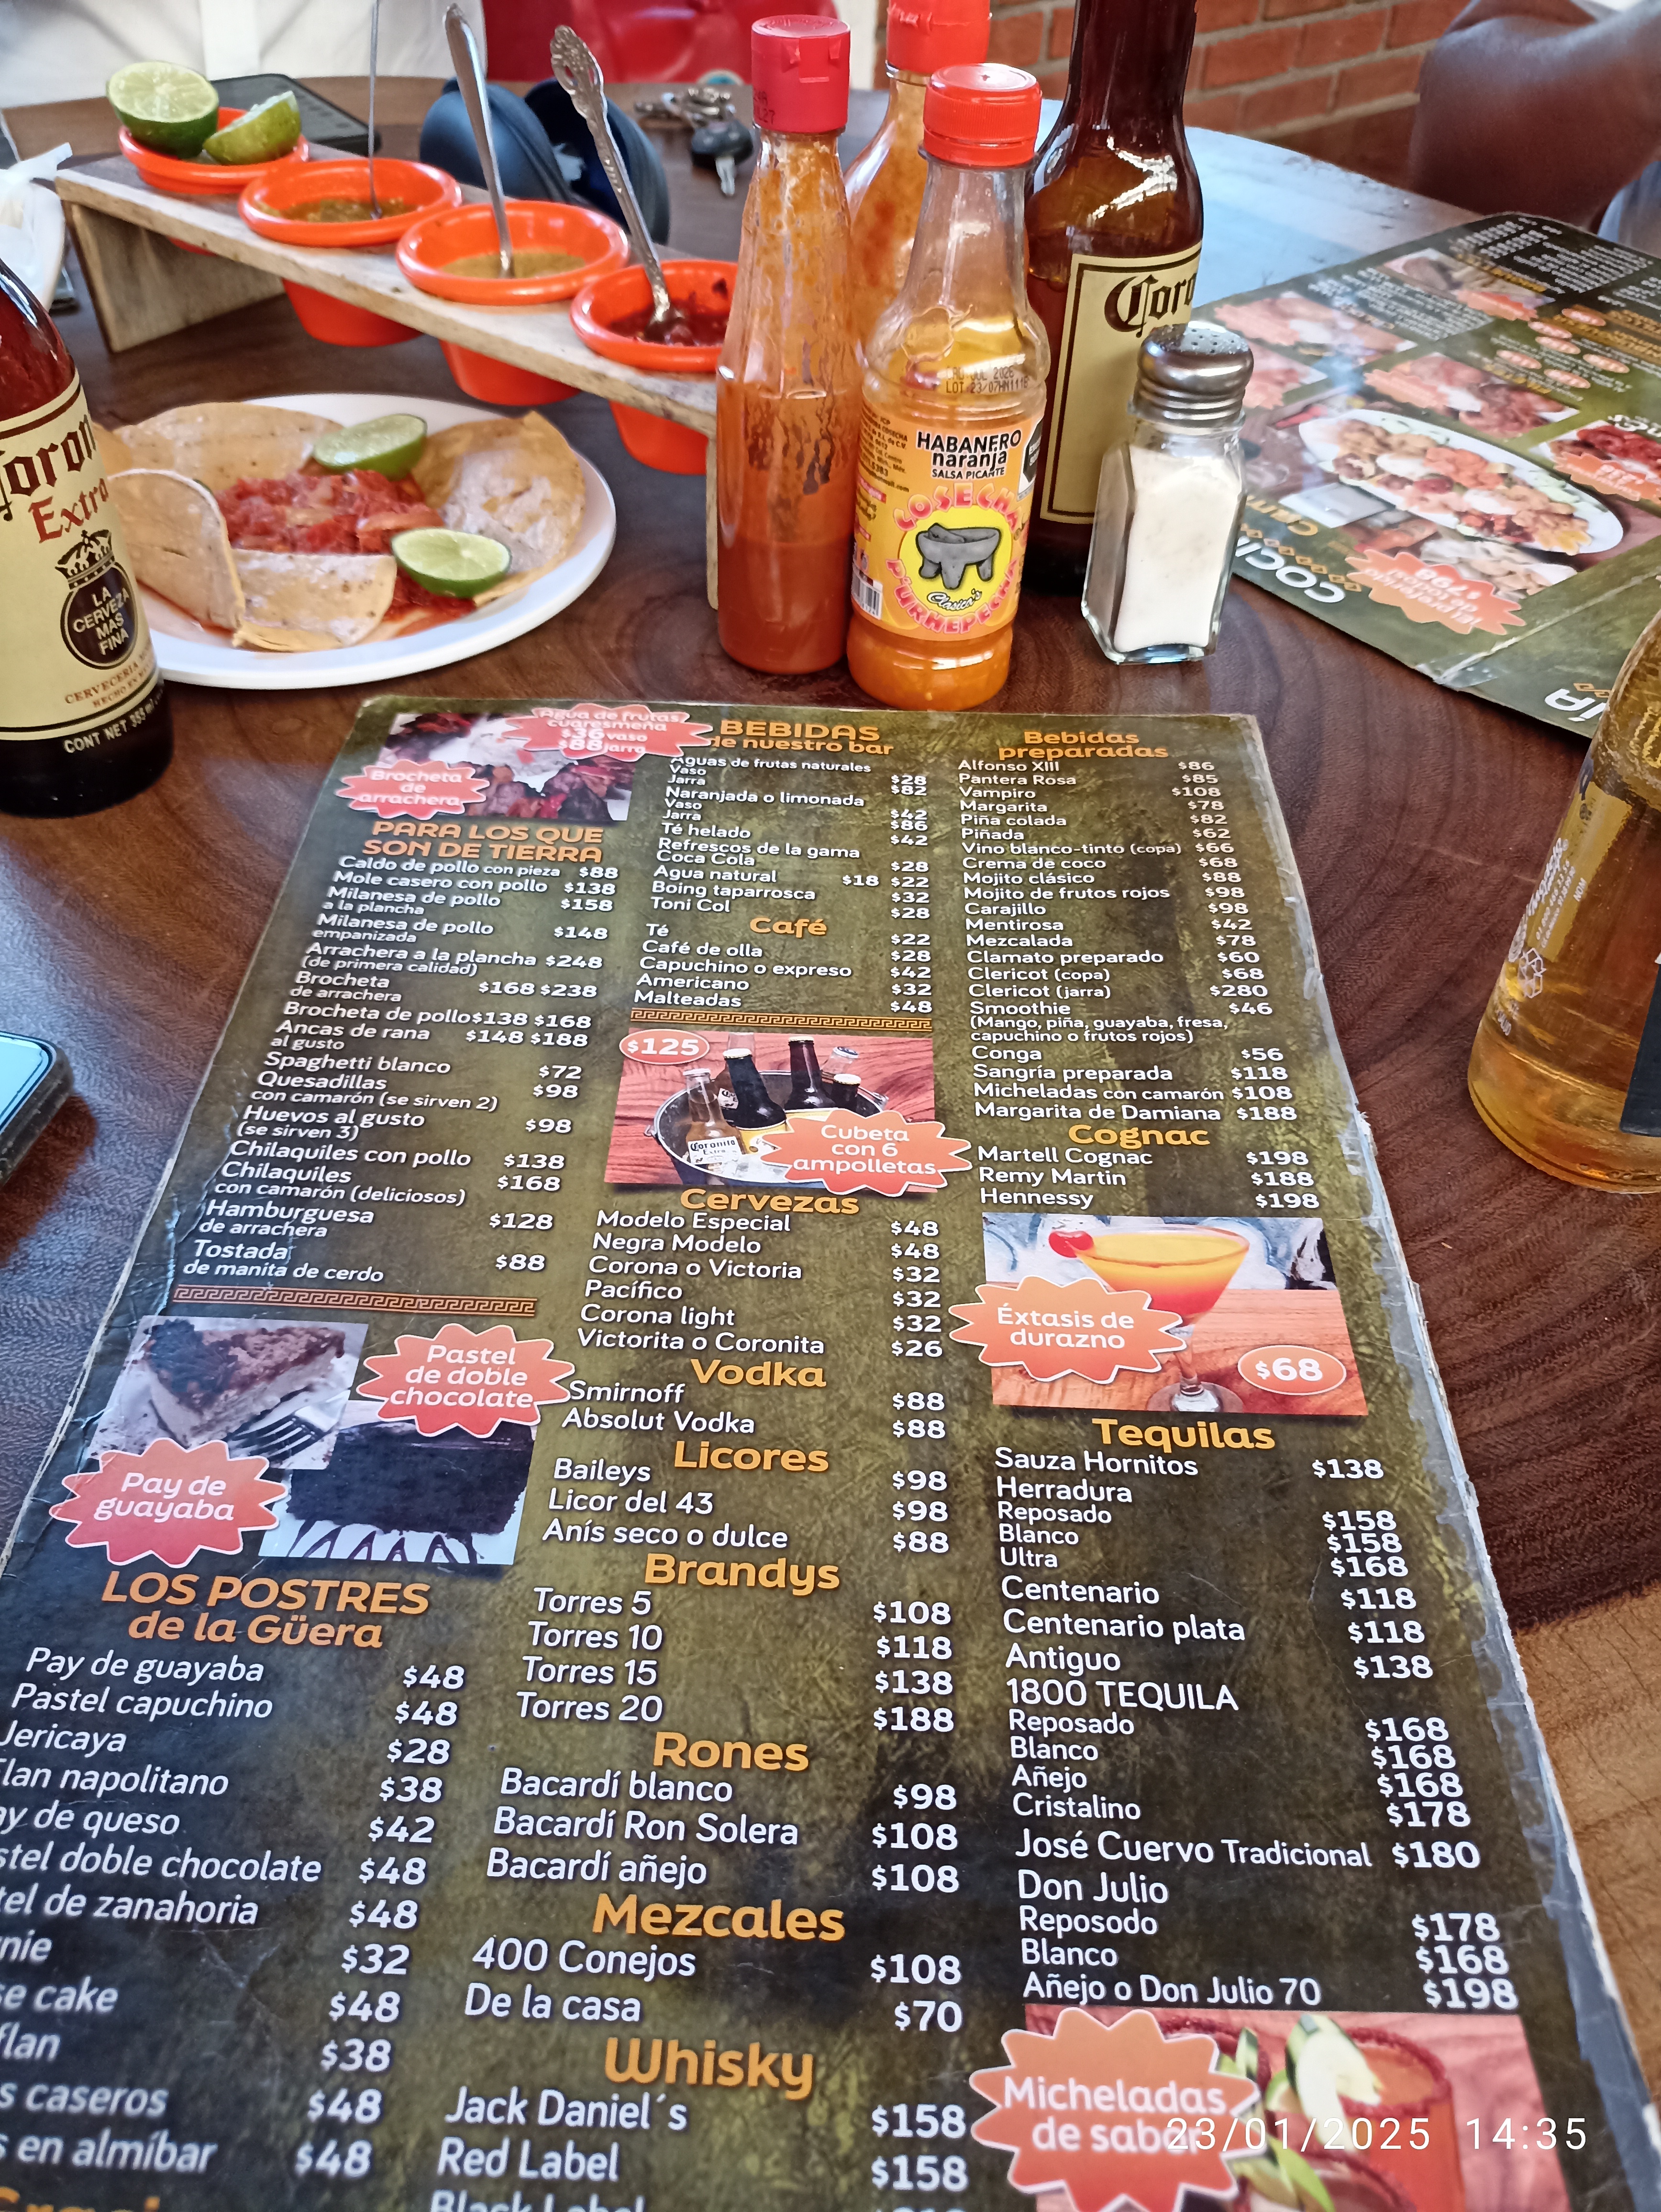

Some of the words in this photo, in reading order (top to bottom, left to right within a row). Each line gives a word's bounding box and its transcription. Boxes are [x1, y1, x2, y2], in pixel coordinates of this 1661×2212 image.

[946, 381, 964, 393] LOT
[917, 430, 1021, 453] HABANERO
[933, 447, 1007, 472] naranja
[932, 469, 963, 479] SALSA
[966, 467, 1005, 479] PICANTE
[92, 586, 112, 607] LA
[73, 587, 130, 633] CERVEZA
[95, 612, 124, 640] MAS
[99, 628, 129, 655] FINA
[539, 709, 590, 720] Agua
[594, 711, 619, 720] de
[622, 713, 679, 722] frutas
[63, 732, 100, 753] CONT
[103, 719, 127, 741] NET
[562, 728, 605, 740] $36
[607, 732, 648, 742] vaso
[721, 719, 879, 741] BEBIDAS
[1024, 731, 1139, 743] Bebidas
[558, 739, 603, 751] $88
[710, 736, 736, 747] de
[743, 739, 842, 751] nuestro
[849, 741, 894, 754] bar
[999, 745, 1168, 761] preparadas
[670, 757, 726, 769] Aguas
[731, 758, 749, 767] de
[754, 759, 797, 768] frutas
[802, 762, 871, 772] naturales
[670, 764, 706, 775] Vaso
[891, 774, 926, 785] $28
[958, 760, 1027, 771] Alfonso
[1032, 762, 1059, 771] XIII
[1178, 762, 1214, 770] $86
[371, 770, 463, 783] Brocheta
[668, 774, 705, 785] Jarra
[891, 785, 926, 796] $82
[400, 783, 426, 794] de
[357, 794, 460, 807] arrachera
[961, 814, 1000, 825] Piña
[1007, 815, 1066, 825] colada
[1190, 814, 1227, 824] $82
[373, 821, 461, 838] PARA
[469, 825, 528, 840] LOS
[536, 827, 603, 844] QUE
[363, 840, 431, 856] SON
[438, 842, 481, 858] DE
[489, 844, 601, 863] TIERRA
[962, 842, 1004, 854] Vino
[1010, 843, 1124, 854] blanco-tinto
[1130, 843, 1181, 855] (copa)
[1196, 843, 1234, 852] $66
[339, 855, 397, 870] Caldo
[400, 859, 426, 871] de
[430, 861, 479, 874] pollo
[517, 865, 560, 877] pieza
[580, 867, 618, 878] $88
[646, 924, 668, 936] Té
[891, 934, 930, 945] $22
[750, 918, 826, 938] Café
[642, 940, 690, 954] Café
[697, 942, 720, 955] de
[727, 944, 762, 957] olla
[891, 950, 930, 962] $28
[627, 1037, 699, 1055] $125
[974, 1064, 1055, 1082] Sangría
[1063, 1065, 1172, 1083] preparada
[1231, 1067, 1288, 1080] $118
[251, 1088, 288, 1103] con
[290, 1092, 374, 1104] camarón
[379, 1092, 409, 1106] (se
[413, 1095, 471, 1108] sirven
[476, 1096, 497, 1112] 2)
[821, 1125, 909, 1141] Cubeta
[1069, 1125, 1210, 1149] Cognac
[690, 1140, 736, 1151] Coronita
[832, 1144, 875, 1156] con
[882, 1143, 897, 1157] 6
[794, 1159, 936, 1174] ampolletas
[681, 1189, 859, 1214] Cervezas
[981, 1188, 1093, 1209] Hennessy
[1256, 1194, 1319, 1208] $198
[194, 1239, 288, 1259] Tostada
[496, 1254, 544, 1271] $88
[593, 1232, 664, 1254] Negra
[672, 1234, 760, 1253] Modelo
[891, 1243, 939, 1259] $48
[183, 1259, 210, 1274] de
[214, 1262, 288, 1276] manita
[293, 1263, 319, 1278] de
[324, 1266, 383, 1282] cerdo
[585, 1280, 682, 1299] Pacífico
[893, 1291, 941, 1307] $32
[998, 1303, 1094, 1327] Éxtasis
[1101, 1312, 1134, 1328] de
[1010, 1328, 1125, 1348] durazno
[427, 1345, 515, 1364] Pastel
[406, 1366, 441, 1383] de
[447, 1367, 527, 1385] doble
[1255, 1358, 1322, 1381] $68
[390, 1387, 532, 1408] chocolate
[1092, 1418, 1275, 1453] Tequilas
[675, 1441, 828, 1471] Licores
[995, 1447, 1075, 1470] Sauza
[1084, 1450, 1198, 1475] Hornitos
[1312, 1459, 1384, 1479] $138
[122, 1472, 182, 1499] Pay
[188, 1476, 226, 1495] de
[554, 1458, 650, 1486] Baileys
[893, 1471, 947, 1491] $98
[94, 1497, 234, 1523] guayaba
[645, 1553, 839, 1595] Brandys
[101, 1571, 199, 1604] LOS
[207, 1574, 430, 1614] POSTRES
[534, 1588, 622, 1614] Torres
[631, 1591, 651, 1615] 5
[874, 1601, 951, 1625] $108
[129, 1611, 184, 1639] de
[194, 1613, 236, 1642] la
[248, 1615, 382, 1648] Güera
[0, 1720, 126, 1758] Jericaya
[387, 1738, 450, 1764] $28
[1016, 1828, 1088, 1858] José
[1098, 1831, 1213, 1863] Cuervo
[1221, 1839, 1372, 1866] Tradicional
[1392, 1841, 1480, 1868] $180
[593, 1893, 844, 1941] Mezcales
[473, 1937, 548, 1971] 400
[559, 1940, 695, 1981] Conejos
[871, 1954, 961, 1984] $108
[605, 2037, 813, 2104] Whisky
[1004, 2076, 1228, 2116] Micheladas
[1033, 2117, 1081, 2150] de
[1092, 2120, 1202, 2155] sabor
[437, 2137, 509, 2178] Red
[519, 2140, 619, 2181] Label
[871, 2155, 968, 2191] $158
